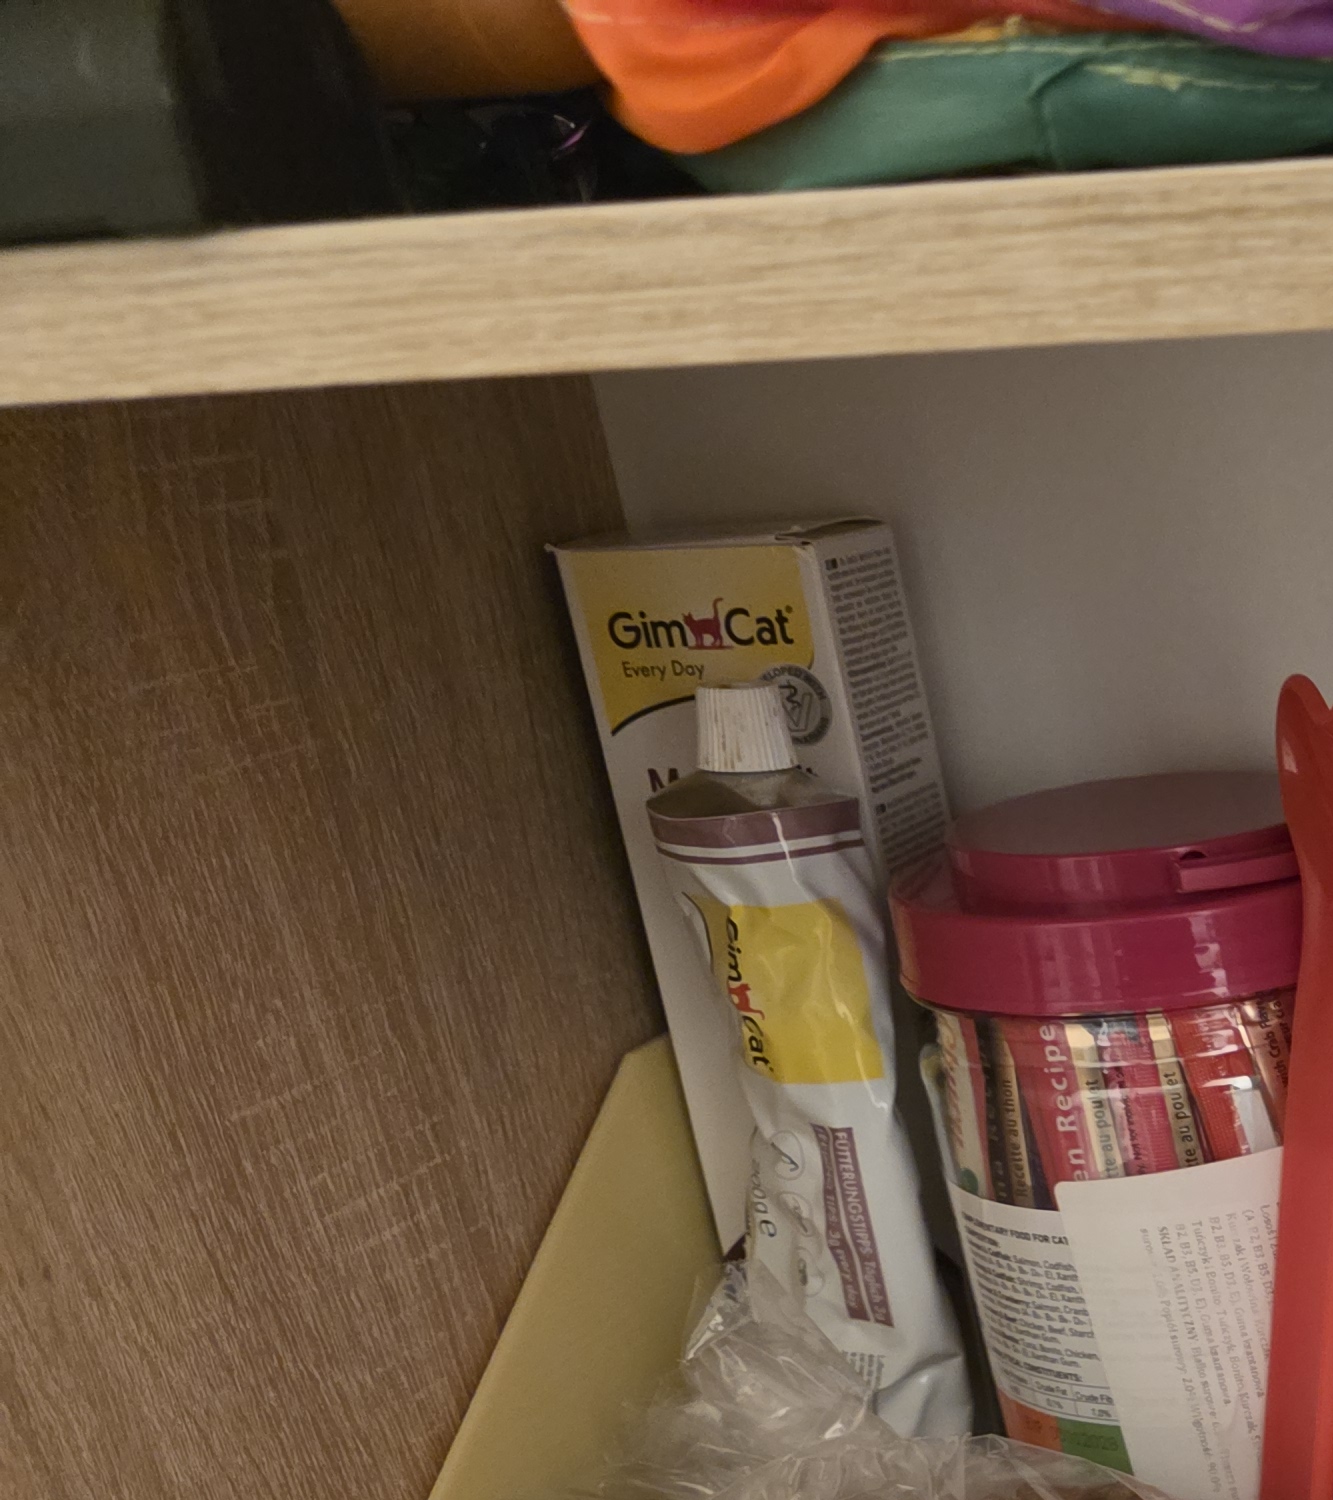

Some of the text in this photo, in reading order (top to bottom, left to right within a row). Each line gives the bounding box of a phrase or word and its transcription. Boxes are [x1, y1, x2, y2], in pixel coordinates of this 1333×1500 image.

[621, 659, 705, 681] Every Day
[1038, 1022, 1080, 1133] Recipe
[1162, 1070, 1192, 1121] pouet
